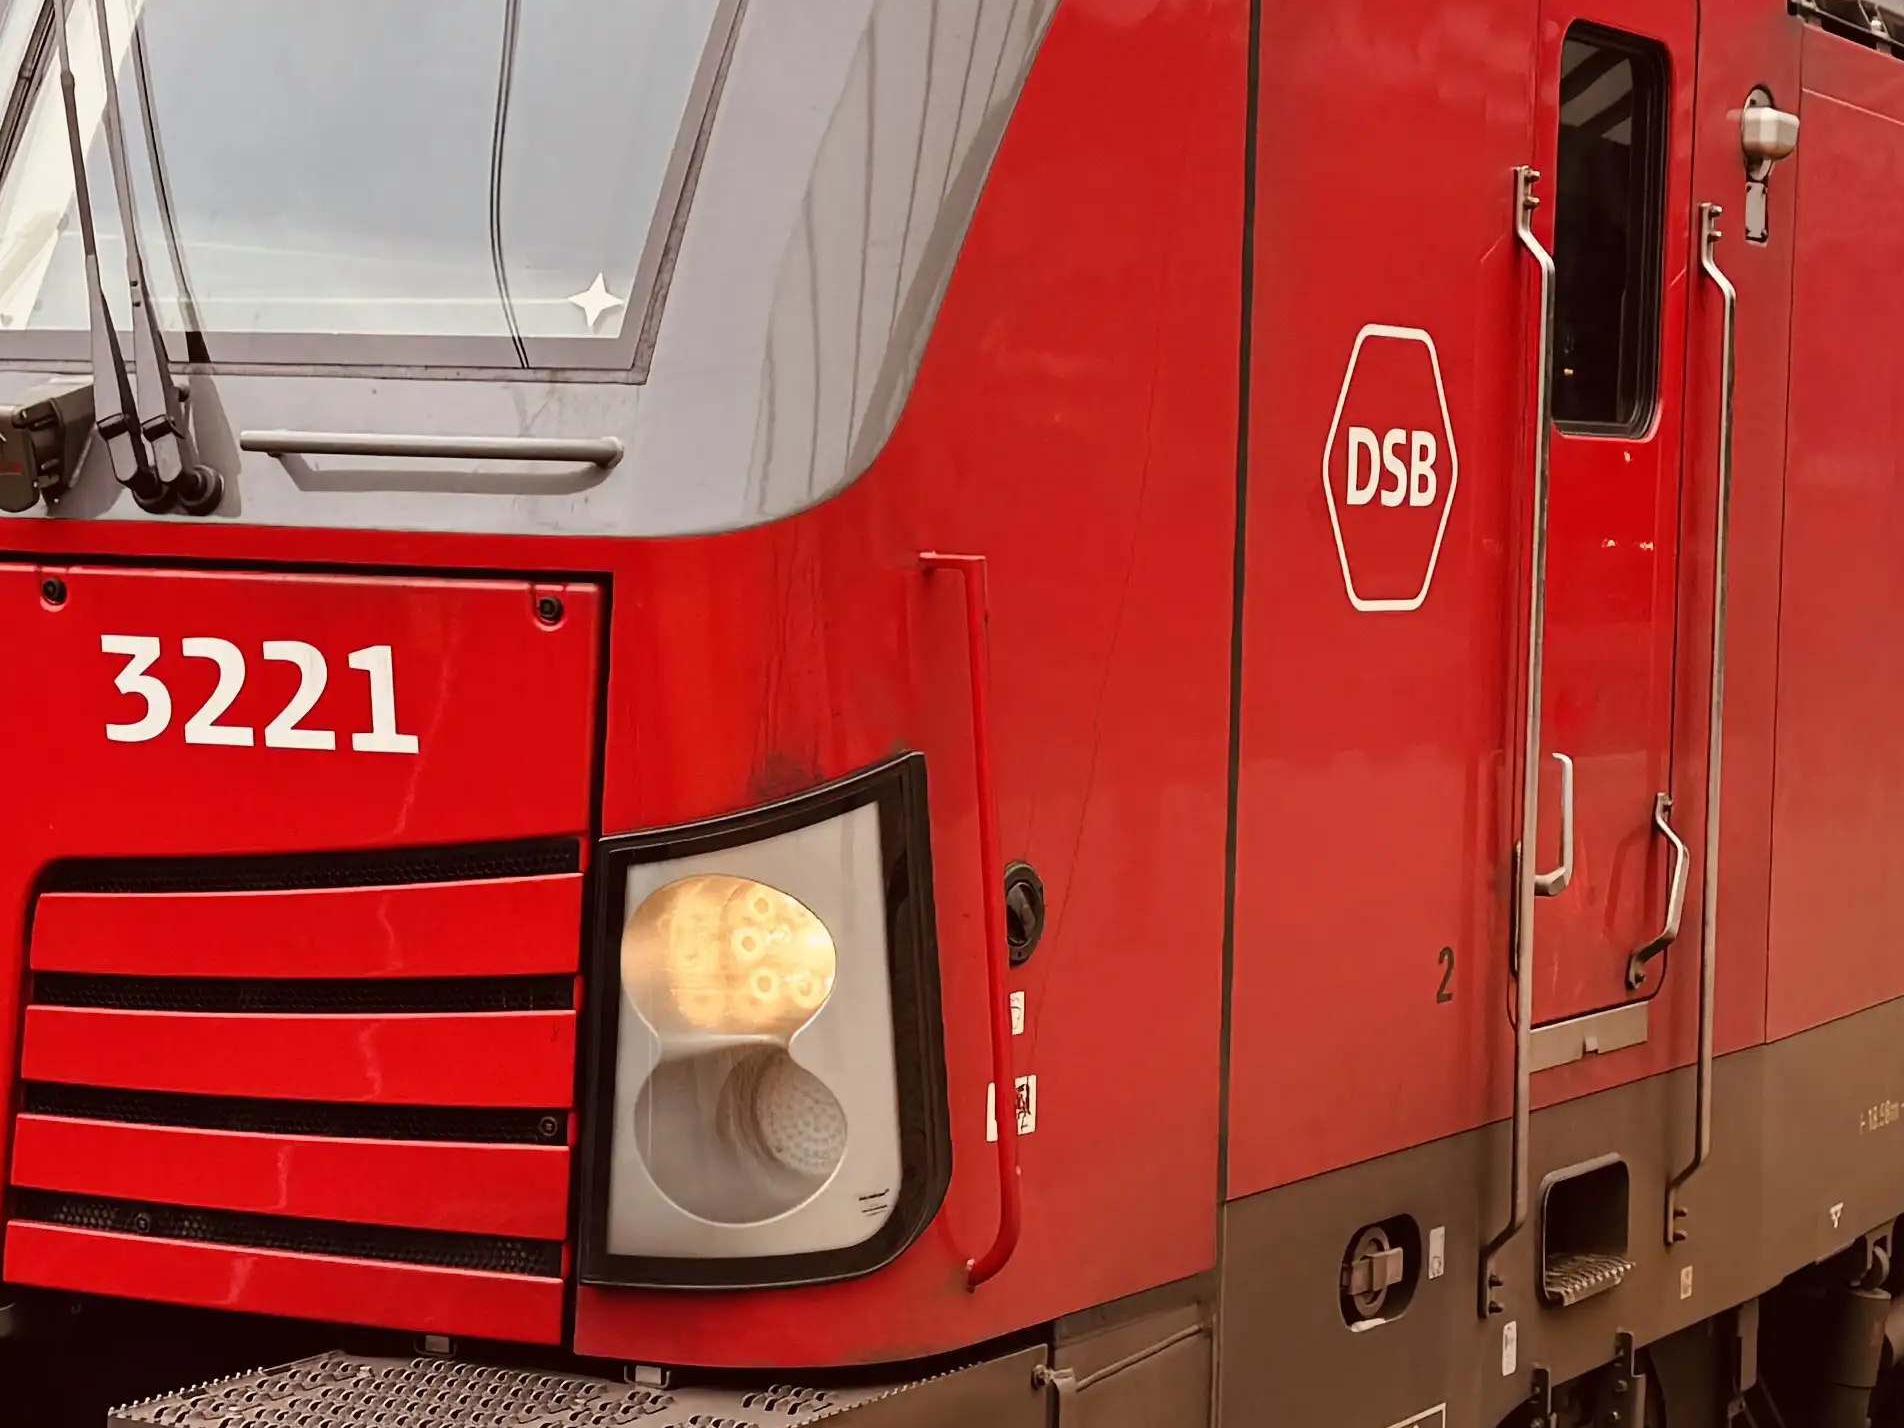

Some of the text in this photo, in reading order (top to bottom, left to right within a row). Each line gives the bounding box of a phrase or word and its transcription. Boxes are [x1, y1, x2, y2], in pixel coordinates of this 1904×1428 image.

[1346, 426, 1437, 508] DSB
[100, 634, 420, 755] 3221
[1436, 945, 1455, 1004] 2
